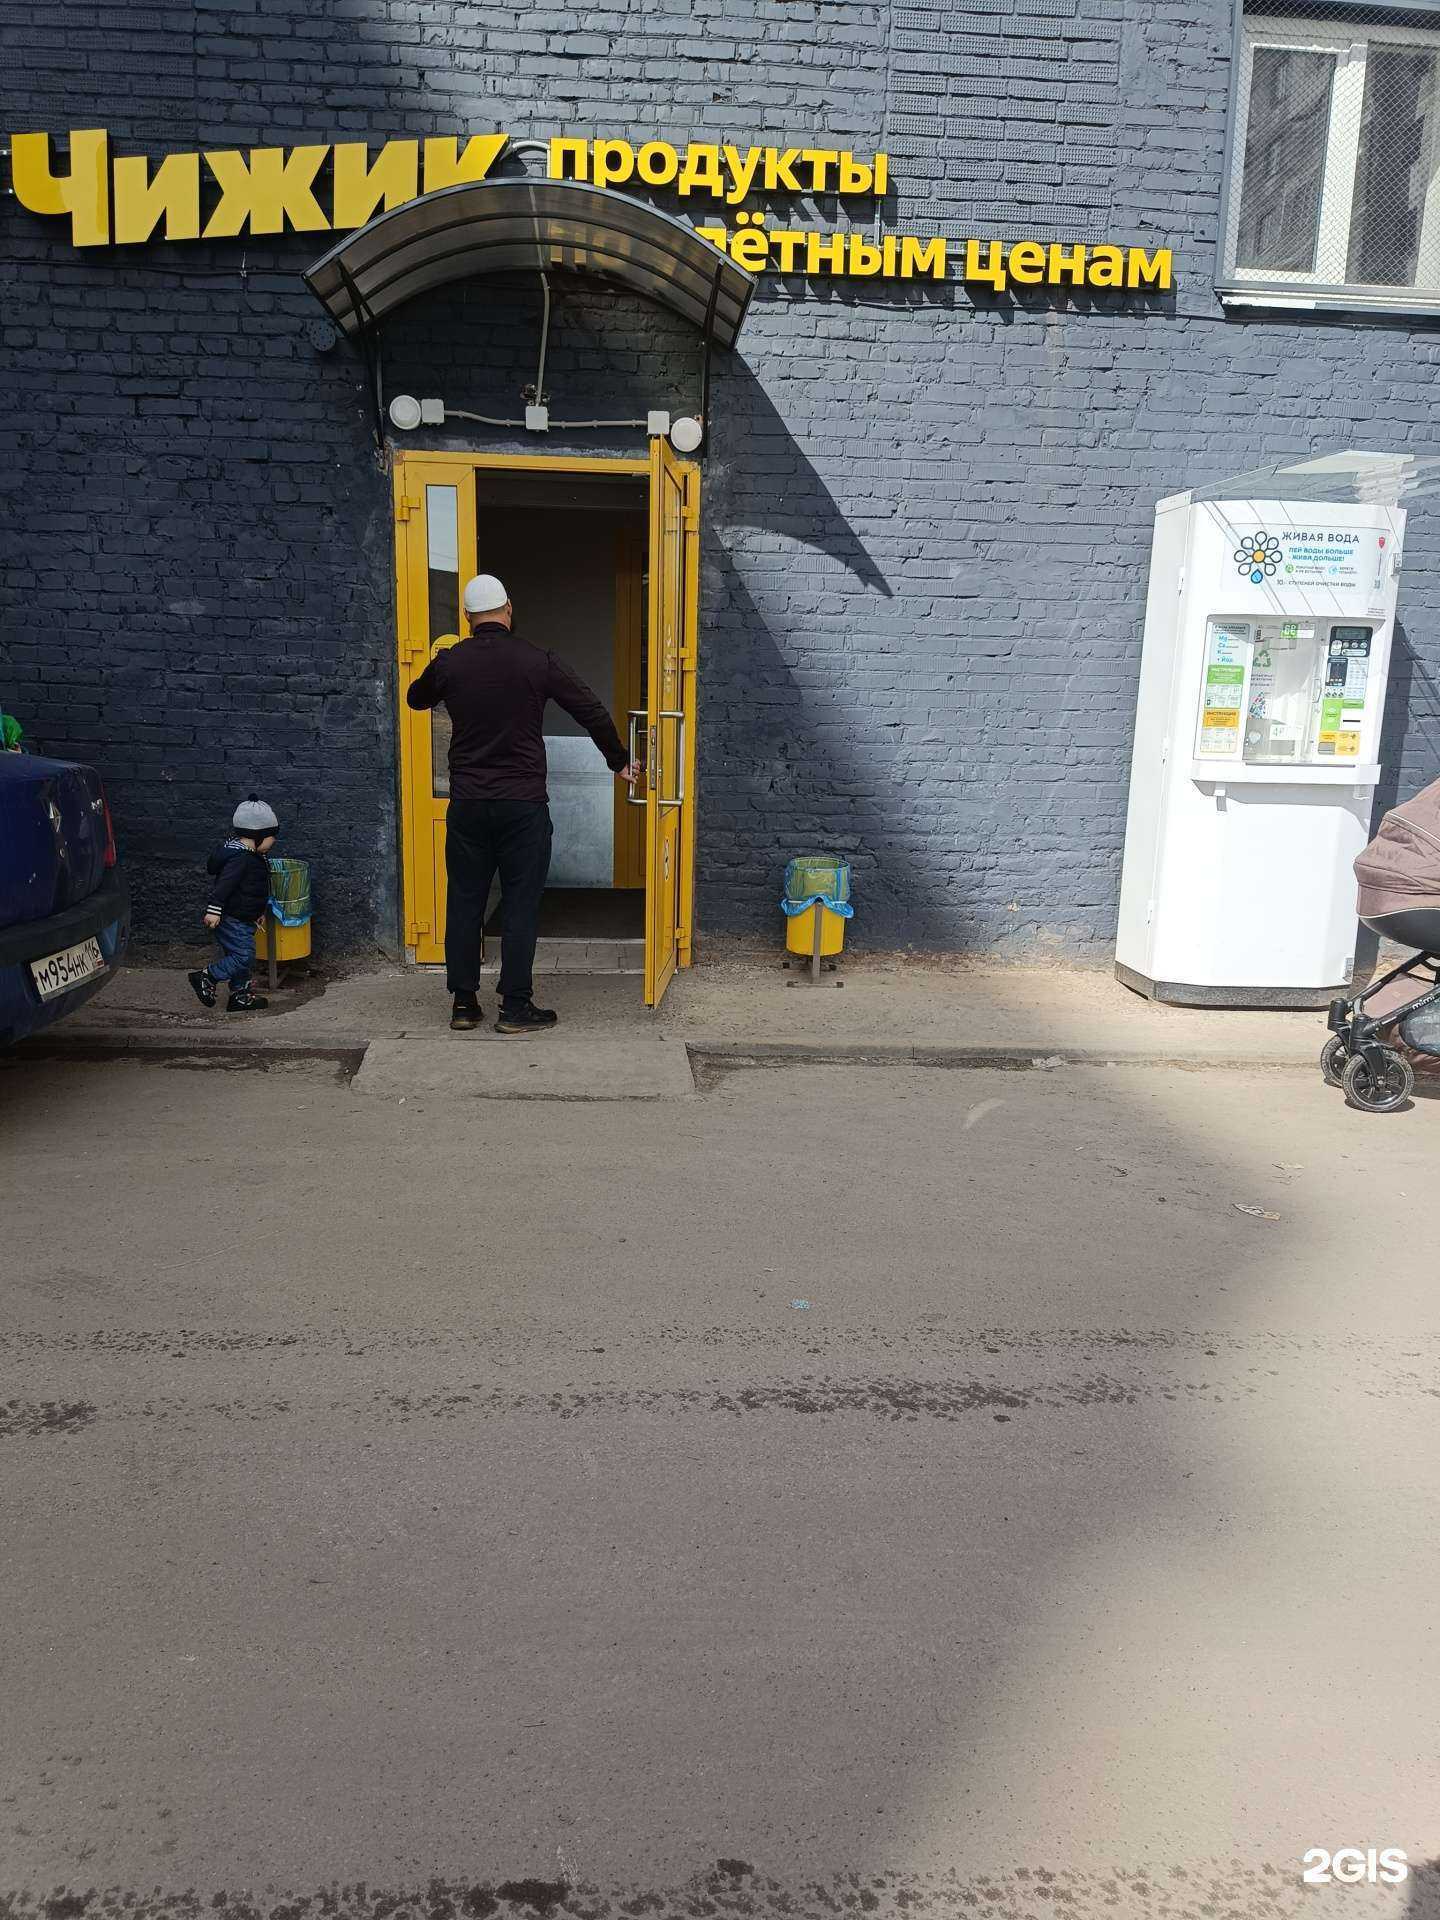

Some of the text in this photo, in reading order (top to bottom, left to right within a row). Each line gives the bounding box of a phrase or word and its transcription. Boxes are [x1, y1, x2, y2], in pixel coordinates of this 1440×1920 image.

[550, 137, 888, 204] продукты
[966, 239, 1172, 291] ценам
[1282, 532, 1360, 543] ЖИВАЯ ВОДА
